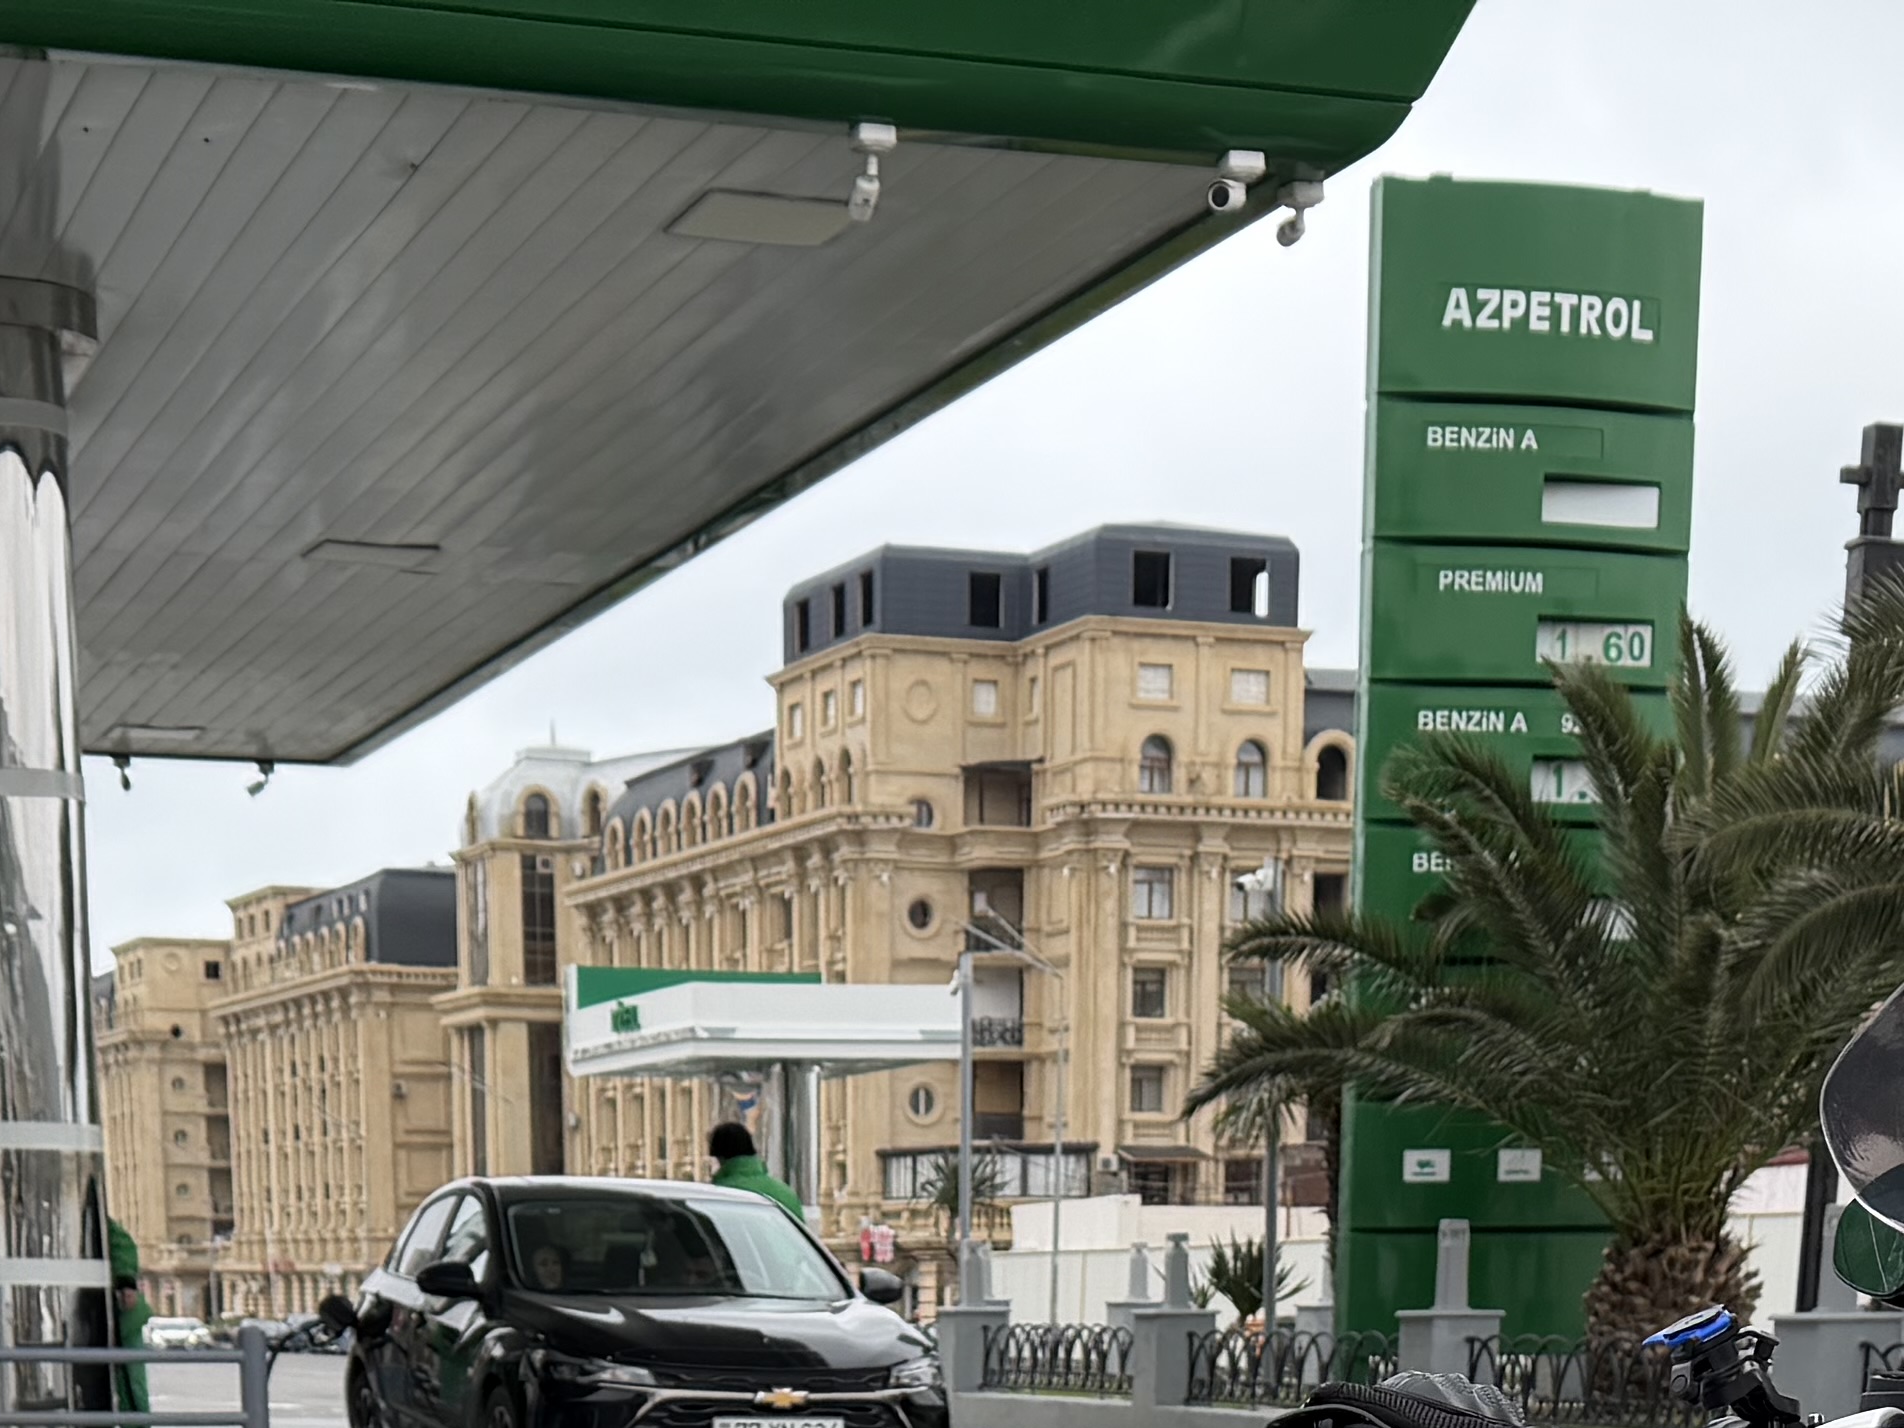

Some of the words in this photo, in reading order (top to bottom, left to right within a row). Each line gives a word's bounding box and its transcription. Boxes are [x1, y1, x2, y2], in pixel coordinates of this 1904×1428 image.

[1442, 287, 1654, 342] AZPETROL
[1520, 428, 1538, 450] A
[1510, 711, 1528, 733] A
